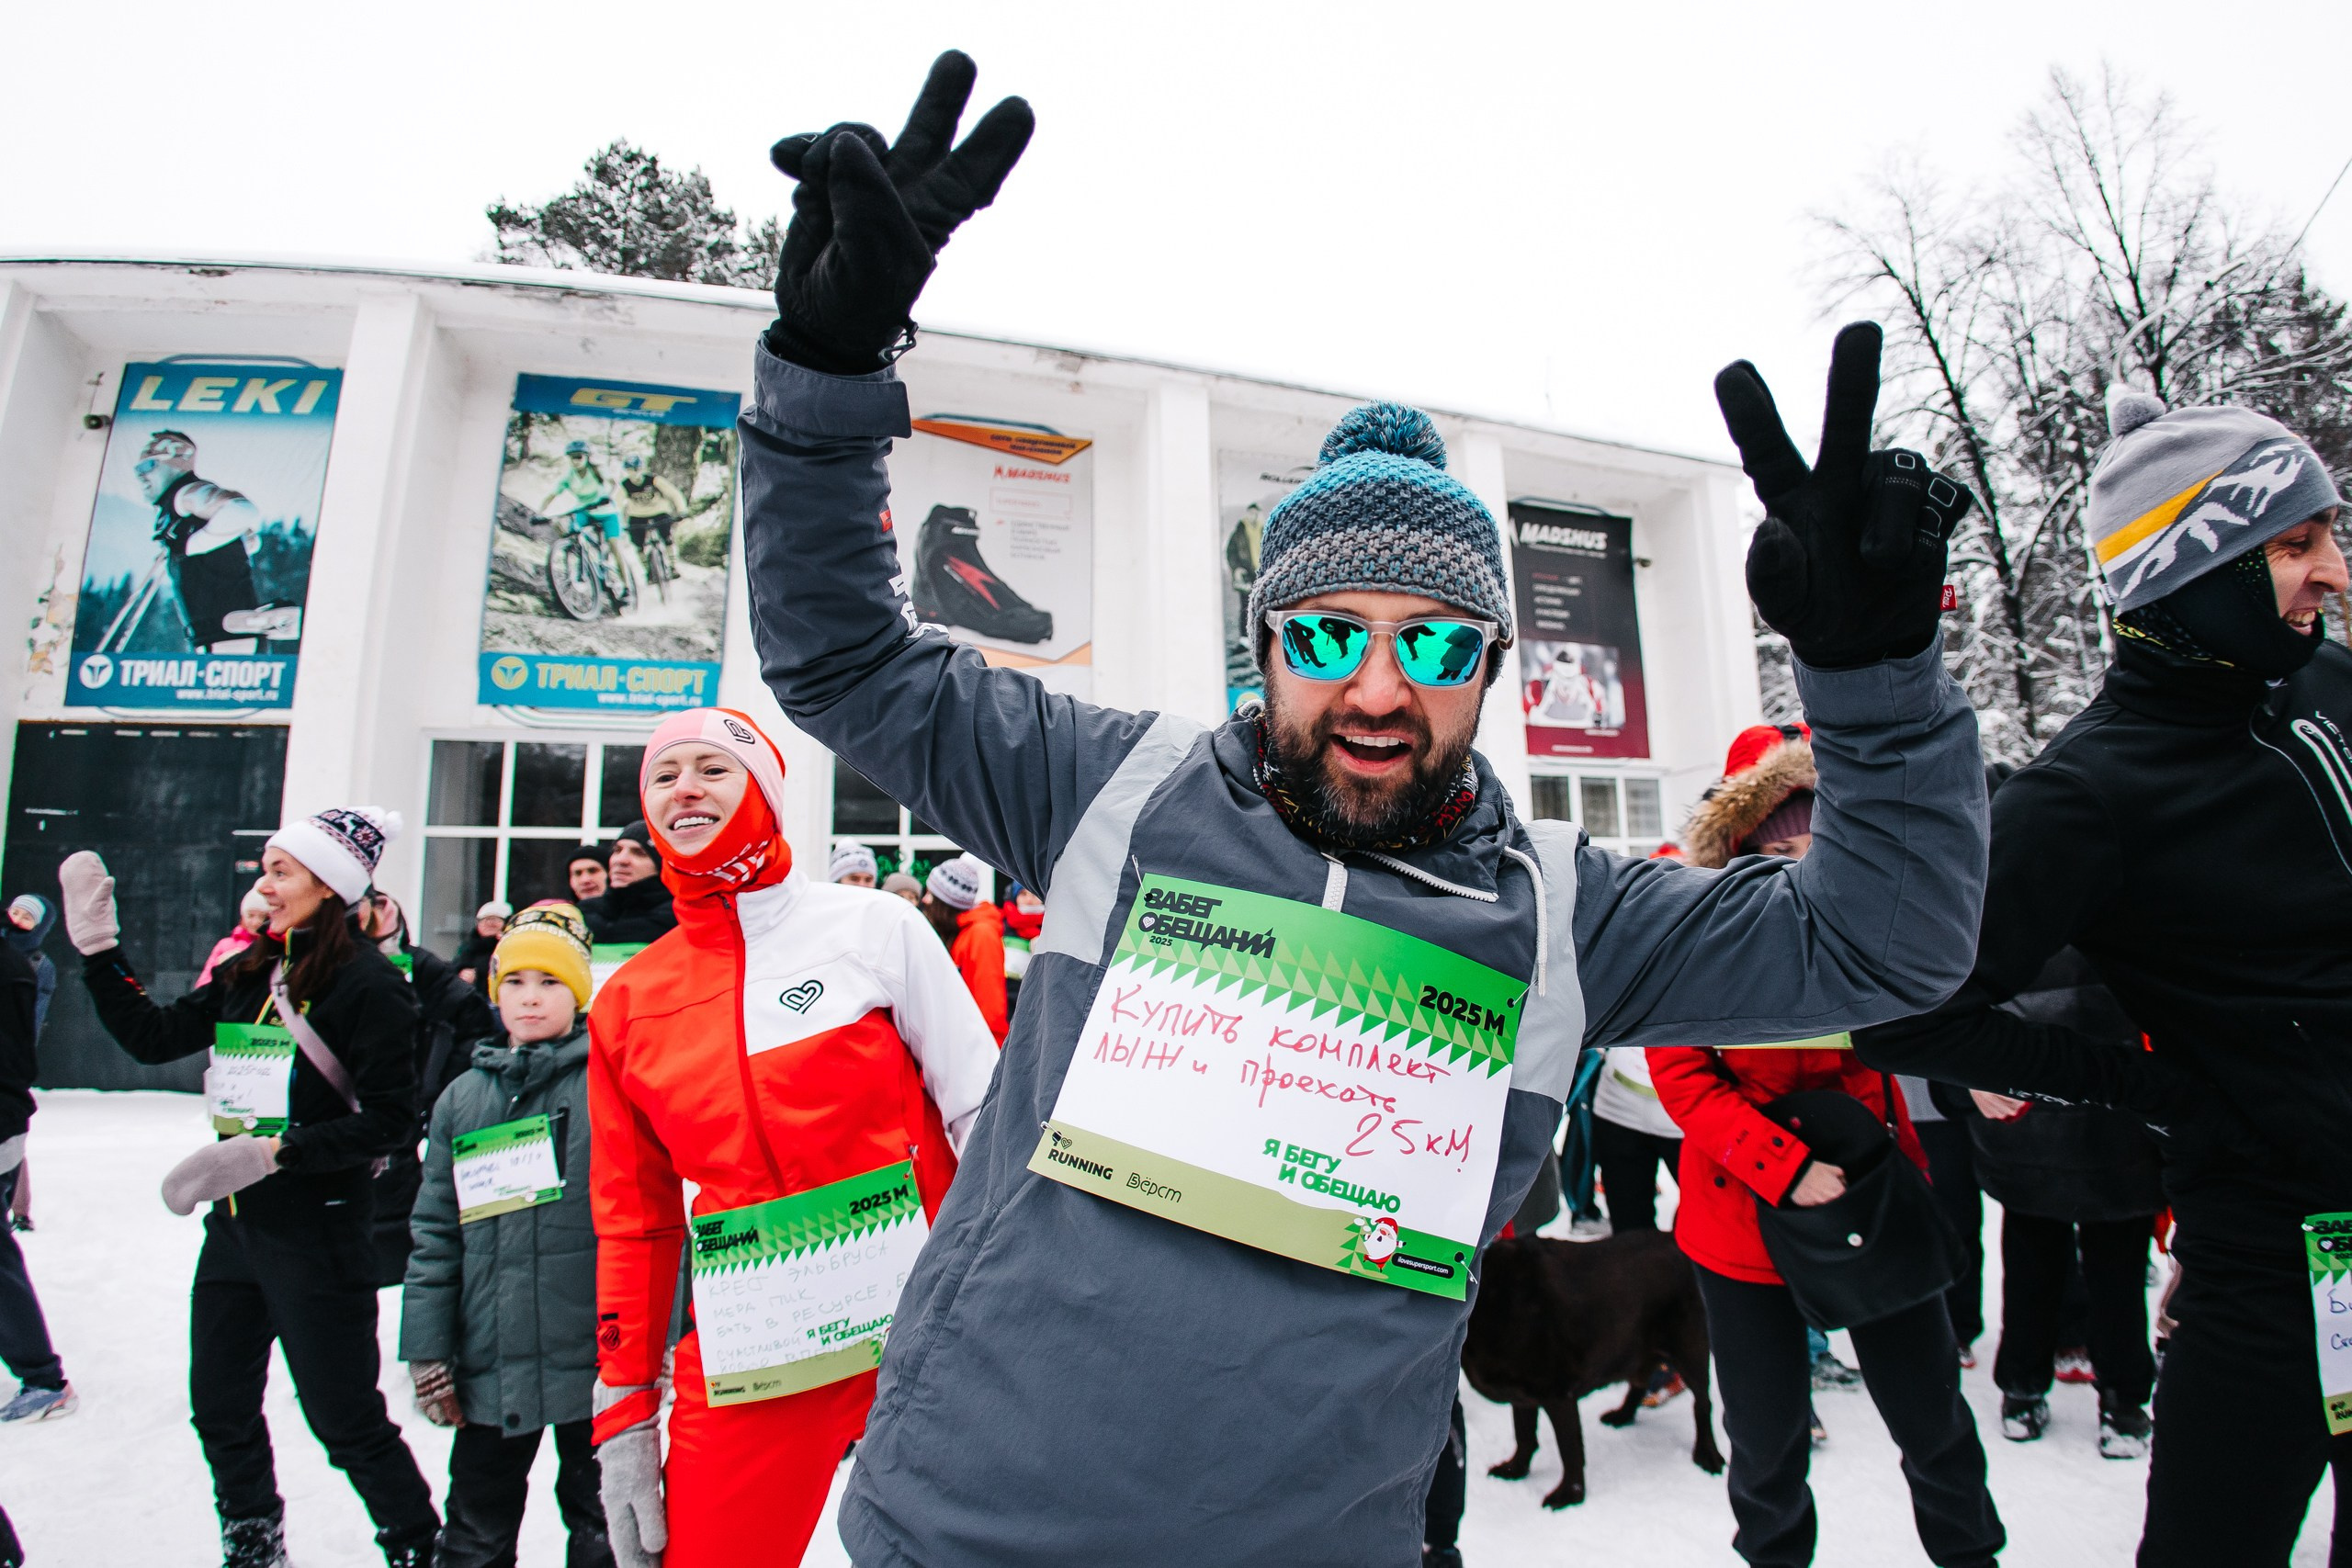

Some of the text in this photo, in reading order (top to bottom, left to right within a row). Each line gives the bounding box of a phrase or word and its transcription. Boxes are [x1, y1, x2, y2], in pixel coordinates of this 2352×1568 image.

[130, 376, 328, 414] LEKI
[570, 388, 698, 412] GT
[1145, 888, 1223, 919] ЗАБЕГ
[1138, 911, 1276, 959] ОБЕЩАНИЙ
[1148, 935, 1173, 947] 2025
[1111, 984, 1451, 1083] Купить комплект
[1047, 1148, 1114, 1180] RUNNING
[1262, 1138, 1342, 1174] Я БЕГУ
[1278, 1163, 1400, 1213] И ОБЕЩАЮ
[696, 1224, 759, 1254] ОБЕЩАНИЙ
[1397, 1255, 1449, 1274] ilovesupersport.com
[766, 1318, 779, 1330] В
[807, 1317, 851, 1339] Я БЕГУ
[821, 1314, 894, 1346] И ОБЕЩАЮ
